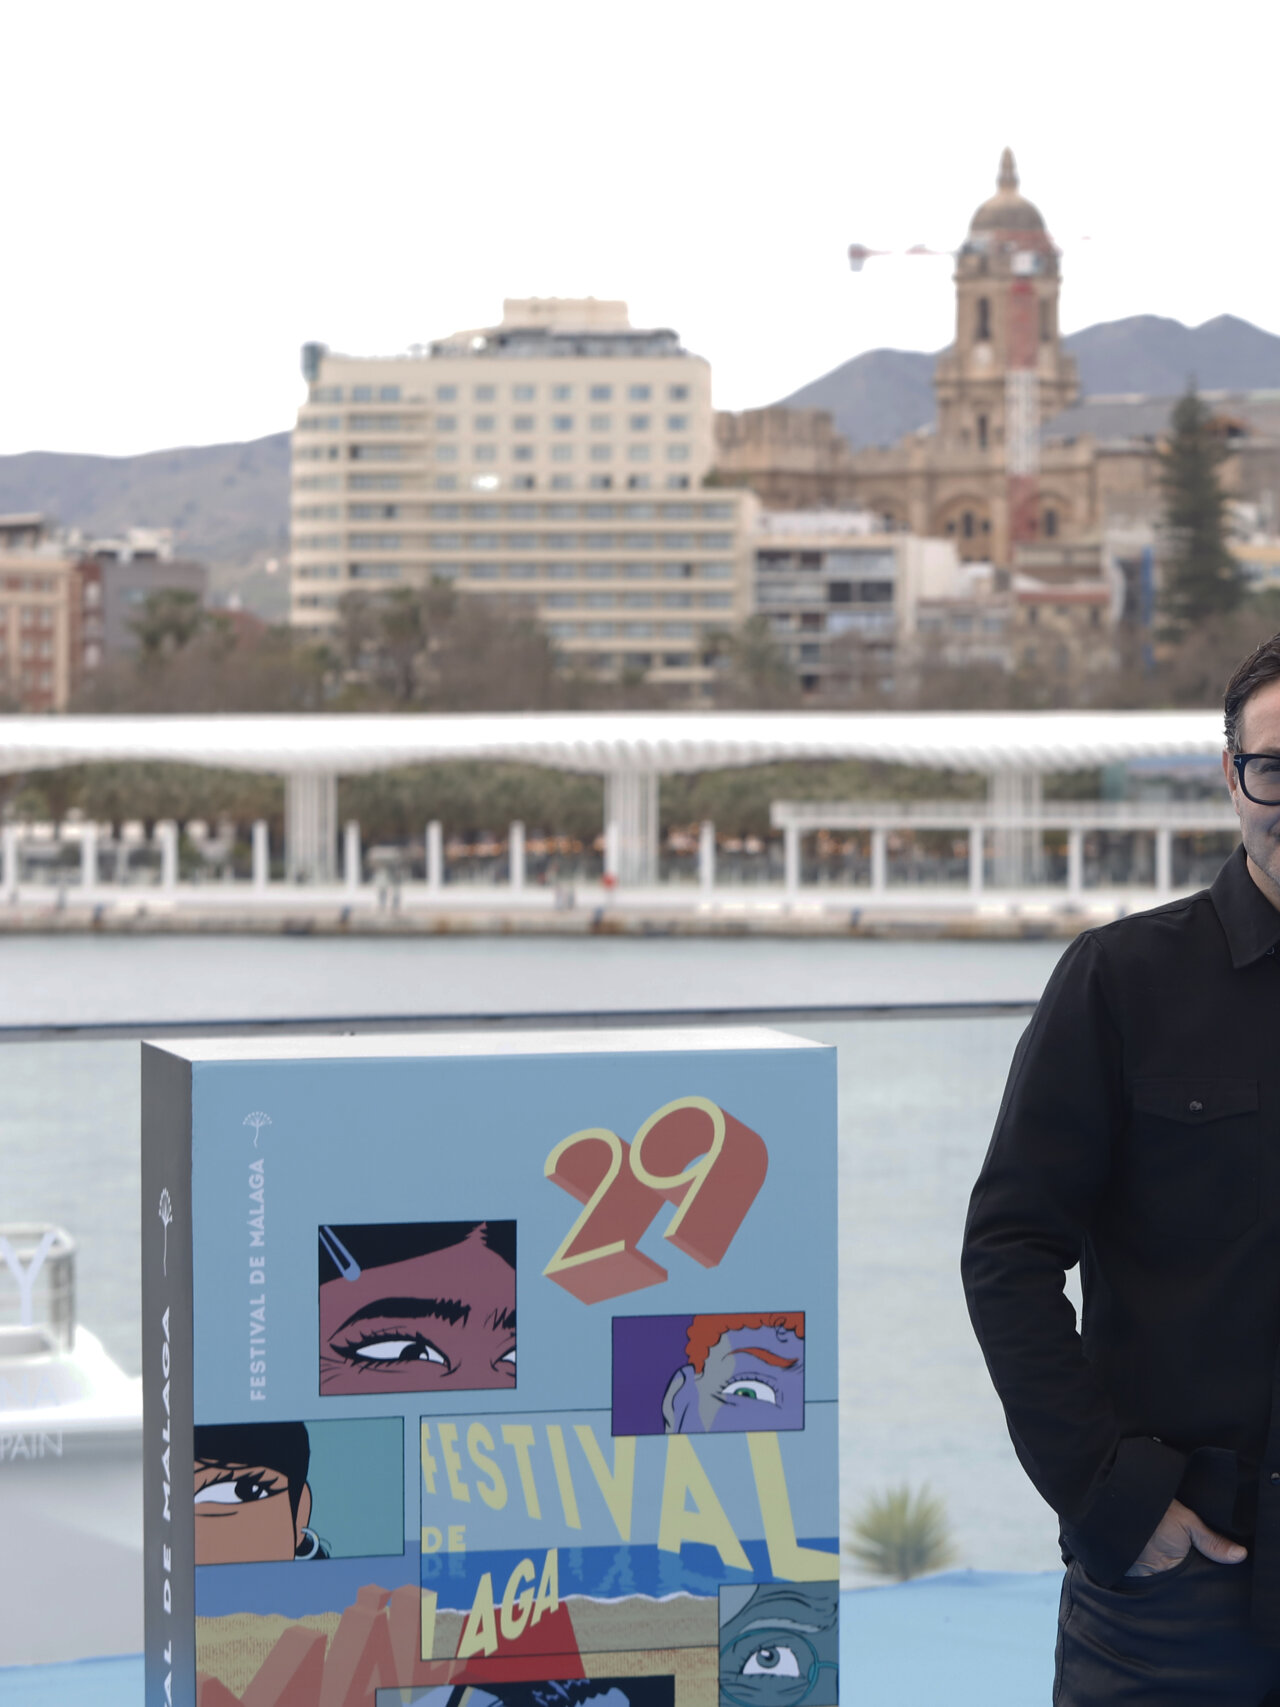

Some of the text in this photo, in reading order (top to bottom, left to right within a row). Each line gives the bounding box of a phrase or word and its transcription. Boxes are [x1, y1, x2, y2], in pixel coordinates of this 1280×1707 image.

[543, 1097, 740, 1282] 29
[249, 1256, 265, 1284] DE
[249, 1294, 266, 1401] FESTIVAL
[421, 1422, 838, 1583] FESTIVAL
[421, 1525, 466, 1554] DE
[163, 1543, 172, 1614] DE
